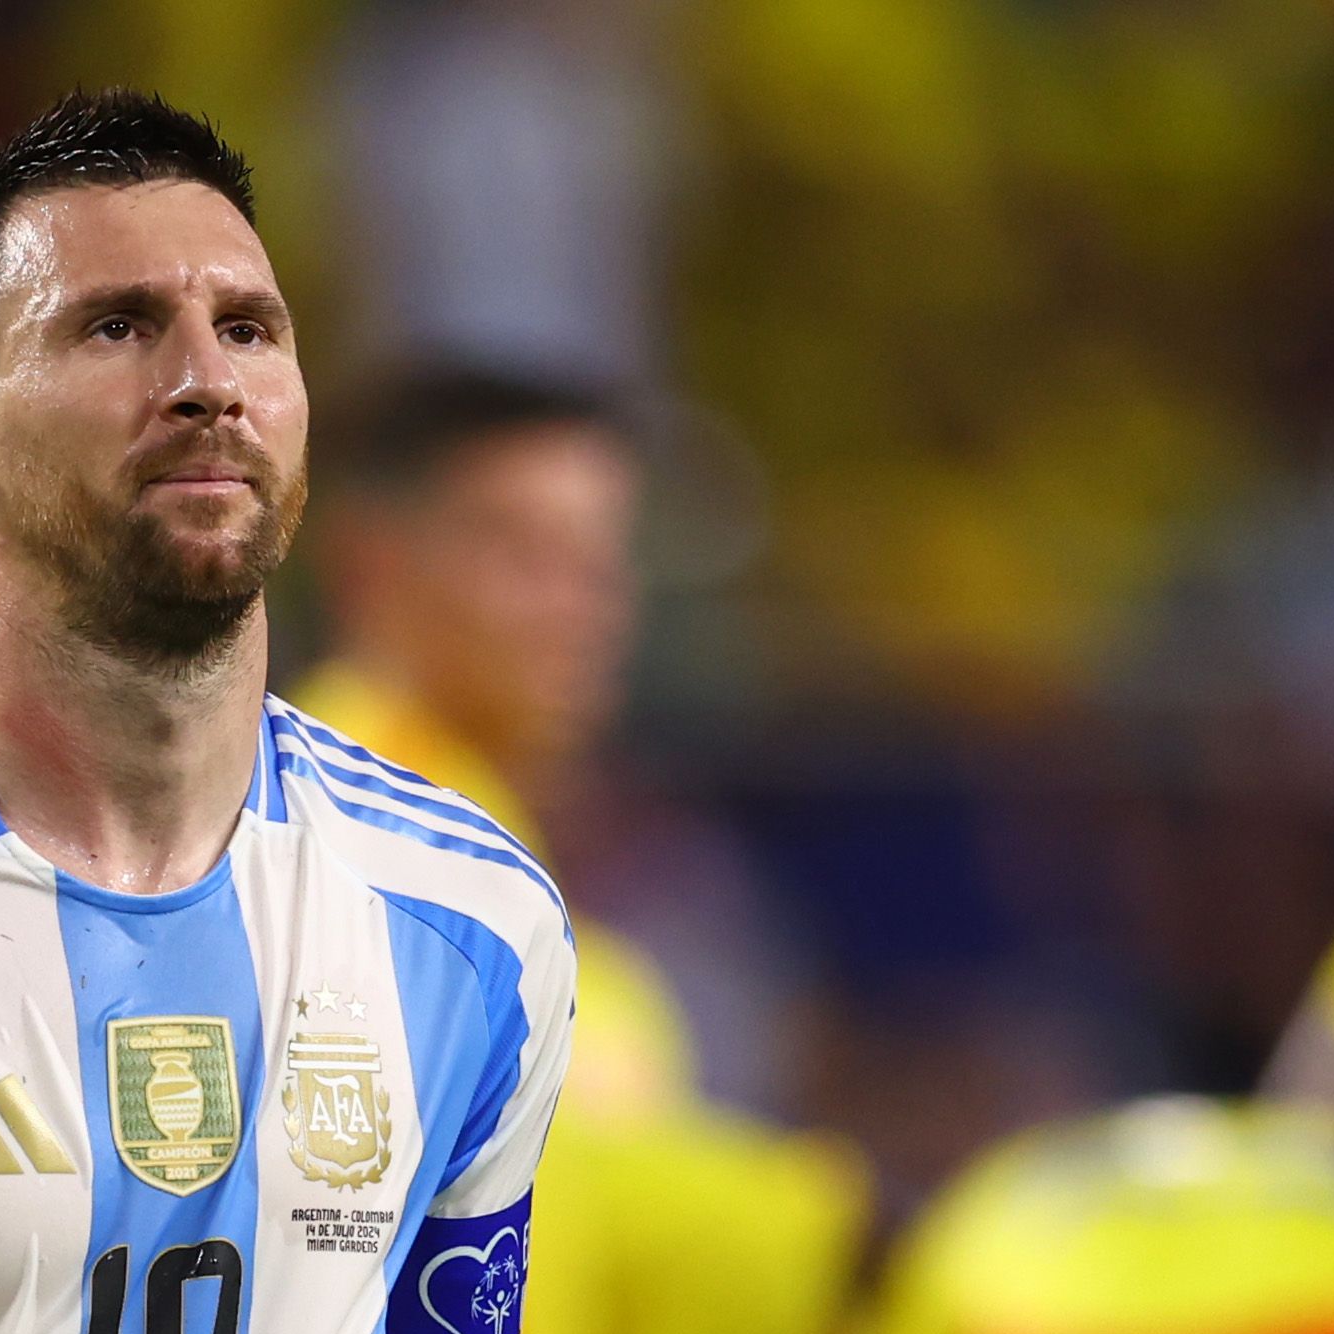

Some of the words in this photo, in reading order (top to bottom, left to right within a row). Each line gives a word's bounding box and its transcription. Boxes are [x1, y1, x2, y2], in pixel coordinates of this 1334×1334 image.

[309, 1072, 373, 1146] AFA
[291, 1208, 341, 1222] ARGENTINA
[351, 1210, 394, 1223] COLOMBIA
[306, 1224, 316, 1236] 14
[318, 1224, 330, 1236] DE
[332, 1225, 355, 1237] JULIO
[357, 1226, 380, 1238] 2024
[307, 1239, 336, 1251] MIAMI
[339, 1241, 378, 1253] GARDENS
